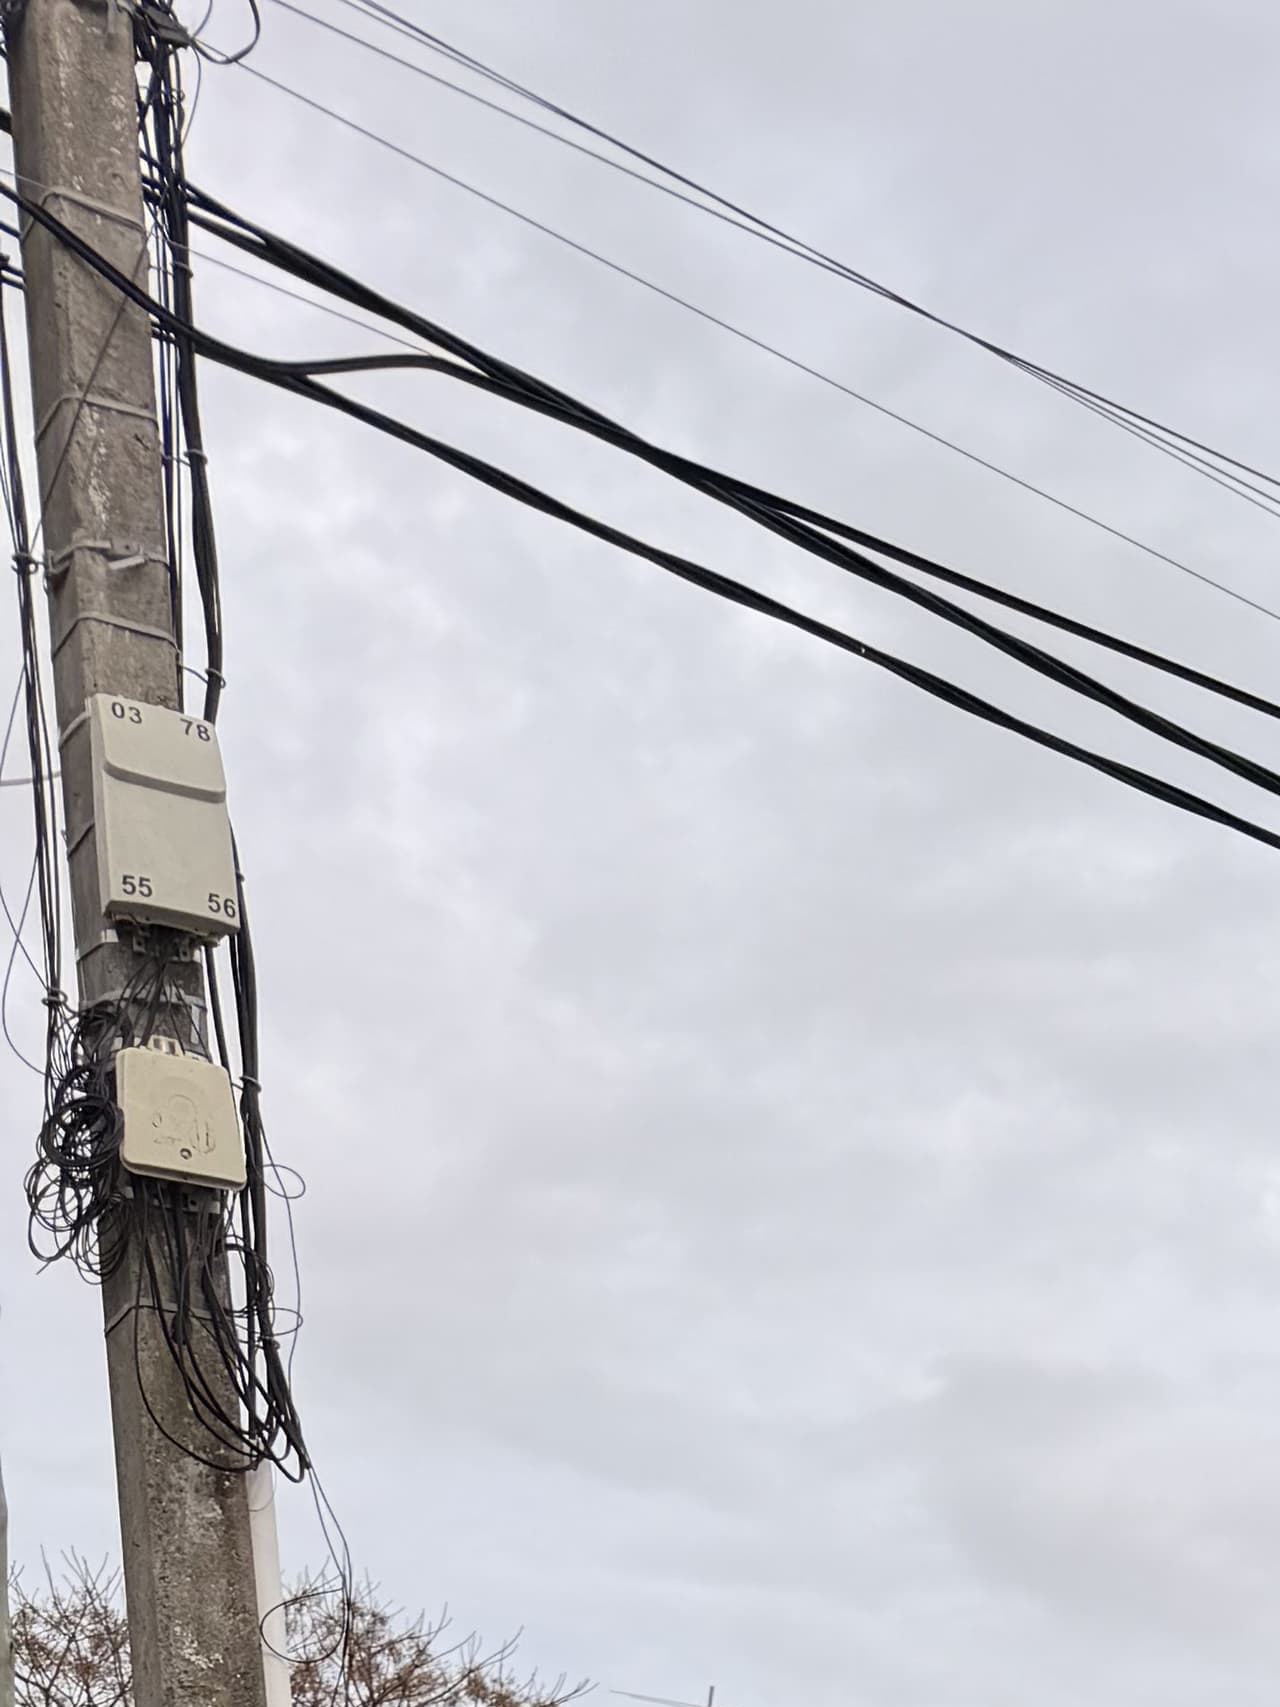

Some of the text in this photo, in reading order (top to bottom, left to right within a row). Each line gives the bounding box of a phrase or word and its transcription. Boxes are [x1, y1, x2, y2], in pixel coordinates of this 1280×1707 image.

[111, 702, 142, 724] 03
[180, 718, 210, 741] 78
[121, 874, 153, 897] 55
[208, 893, 236, 918] 56
